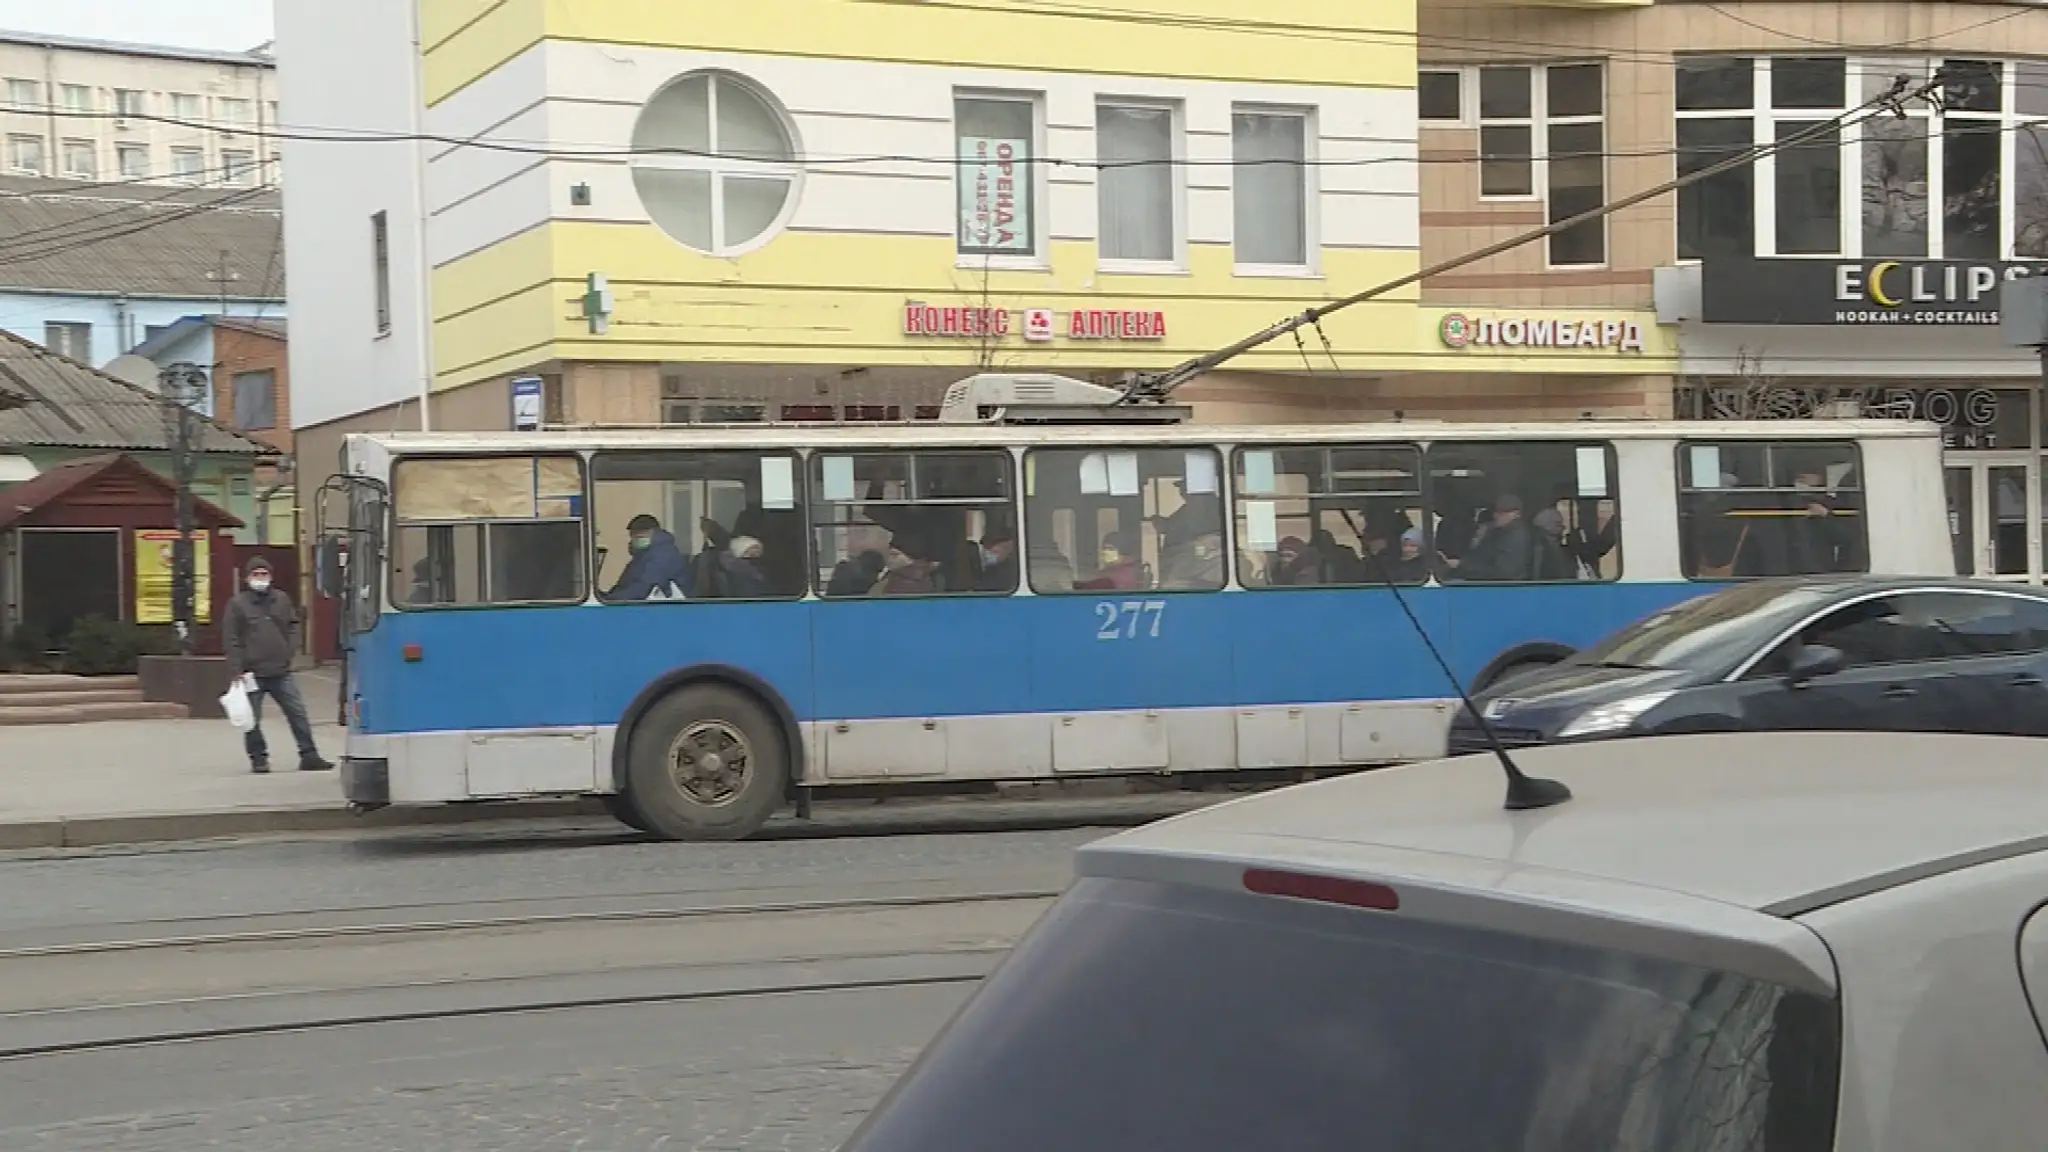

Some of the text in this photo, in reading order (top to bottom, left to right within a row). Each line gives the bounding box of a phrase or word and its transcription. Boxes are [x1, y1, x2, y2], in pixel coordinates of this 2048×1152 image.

[993, 142, 1013, 245] ОРЕНДА
[1836, 261, 2047, 308] ECLIP
[905, 306, 1166, 338] КОНЕКС АПТЕКА
[1475, 317, 1644, 351] ЛОМБАРД
[1836, 311, 1899, 323] HOOKAH
[1914, 311, 1998, 324] COCKTAILS
[1095, 601, 1168, 639] 277
